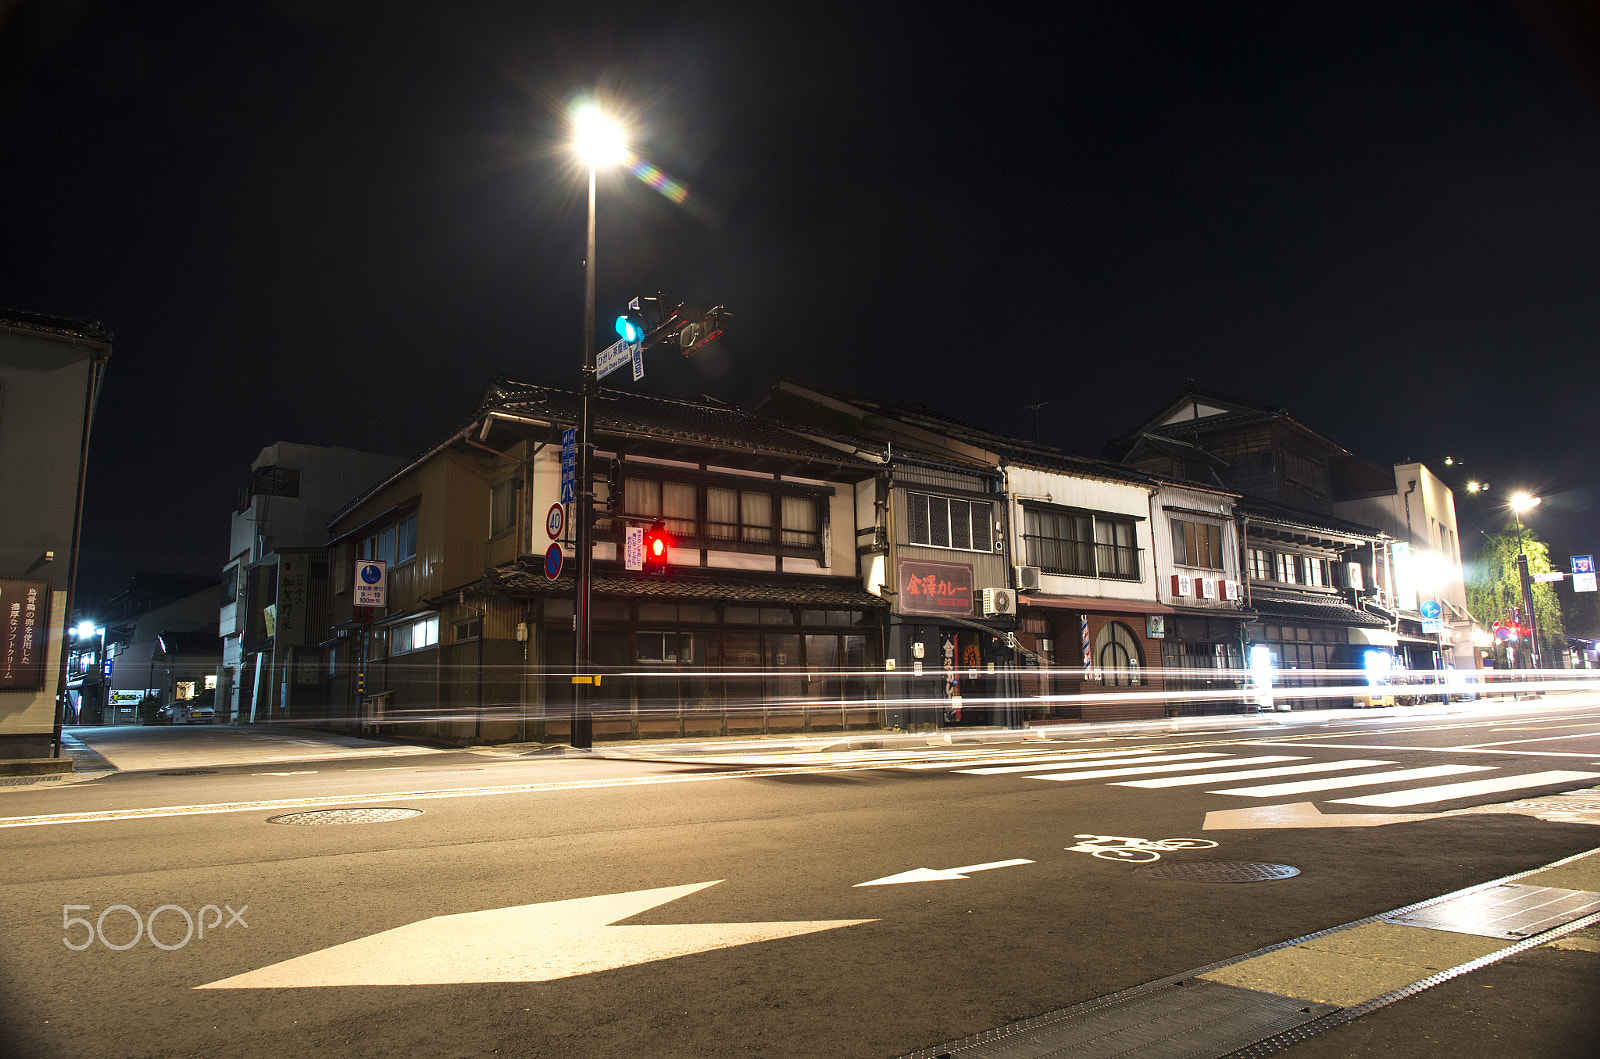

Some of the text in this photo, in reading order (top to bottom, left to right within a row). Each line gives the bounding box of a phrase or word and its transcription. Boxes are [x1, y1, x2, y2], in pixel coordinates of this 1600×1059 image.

[598, 340, 628, 366] ひがし茶屋街
[549, 513, 560, 529] 40
[906, 572, 968, 598] 金澤カレー
[4, 602, 20, 679] 濃厚なソフトクリーム
